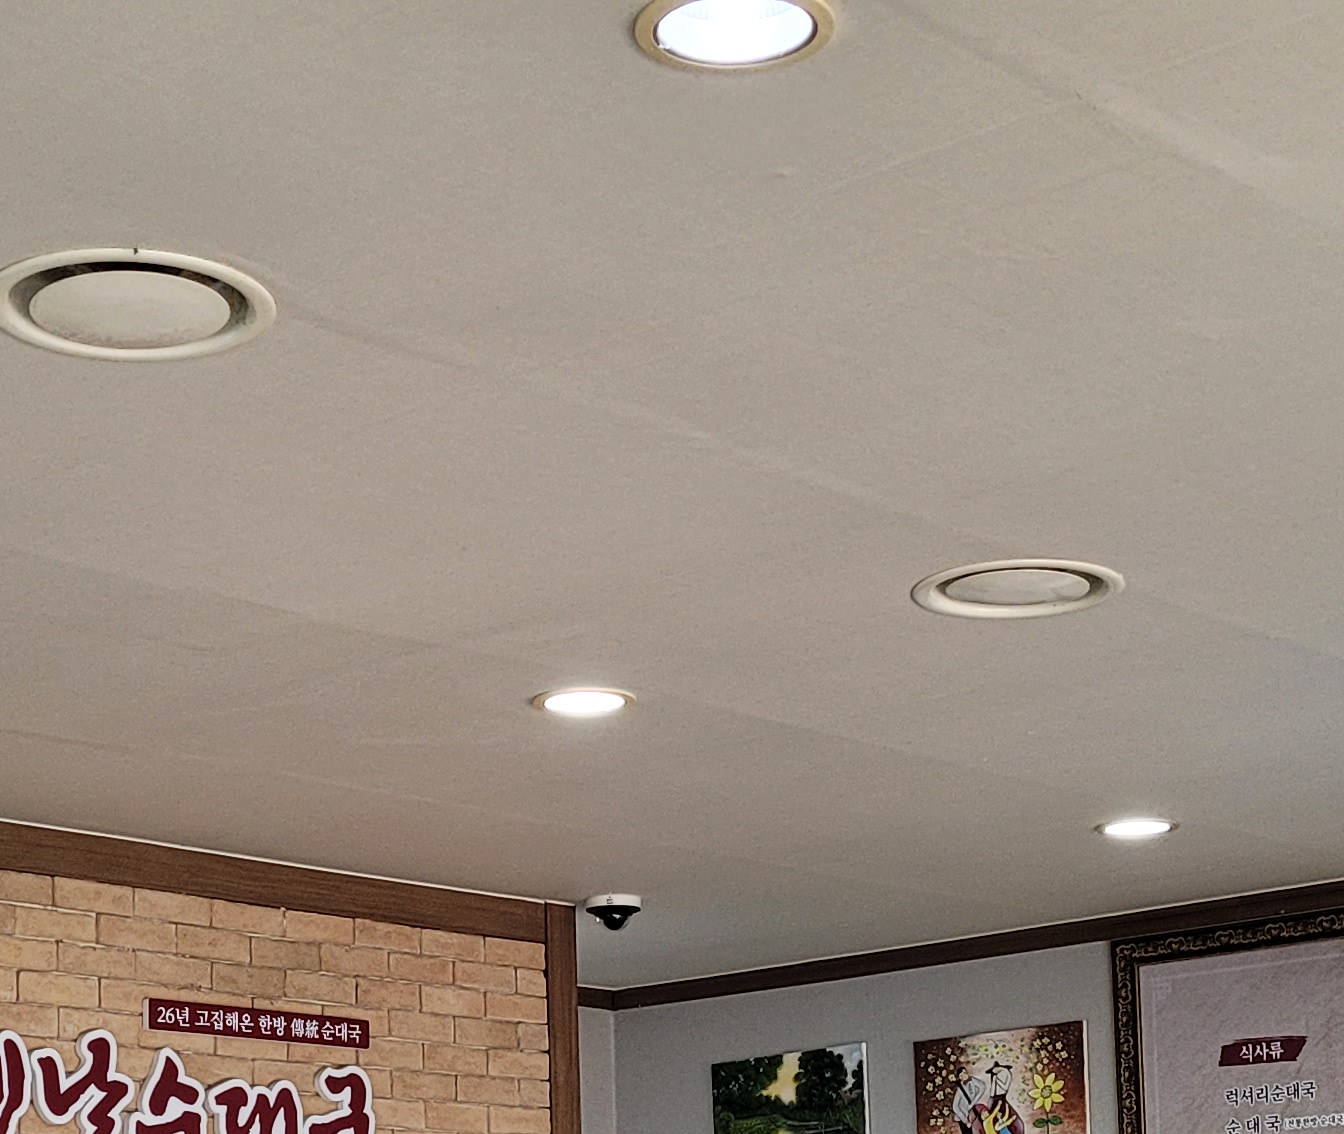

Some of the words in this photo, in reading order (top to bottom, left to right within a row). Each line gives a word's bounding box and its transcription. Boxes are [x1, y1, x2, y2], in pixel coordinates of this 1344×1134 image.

[157, 1007, 190, 1027] 26년
[194, 1010, 254, 1033] 고집해온
[258, 1015, 287, 1036] 한방
[321, 1023, 362, 1044] 순대국
[1240, 1041, 1284, 1062] 식사류
[1225, 1081, 1317, 1107] 럭셔리순대국
